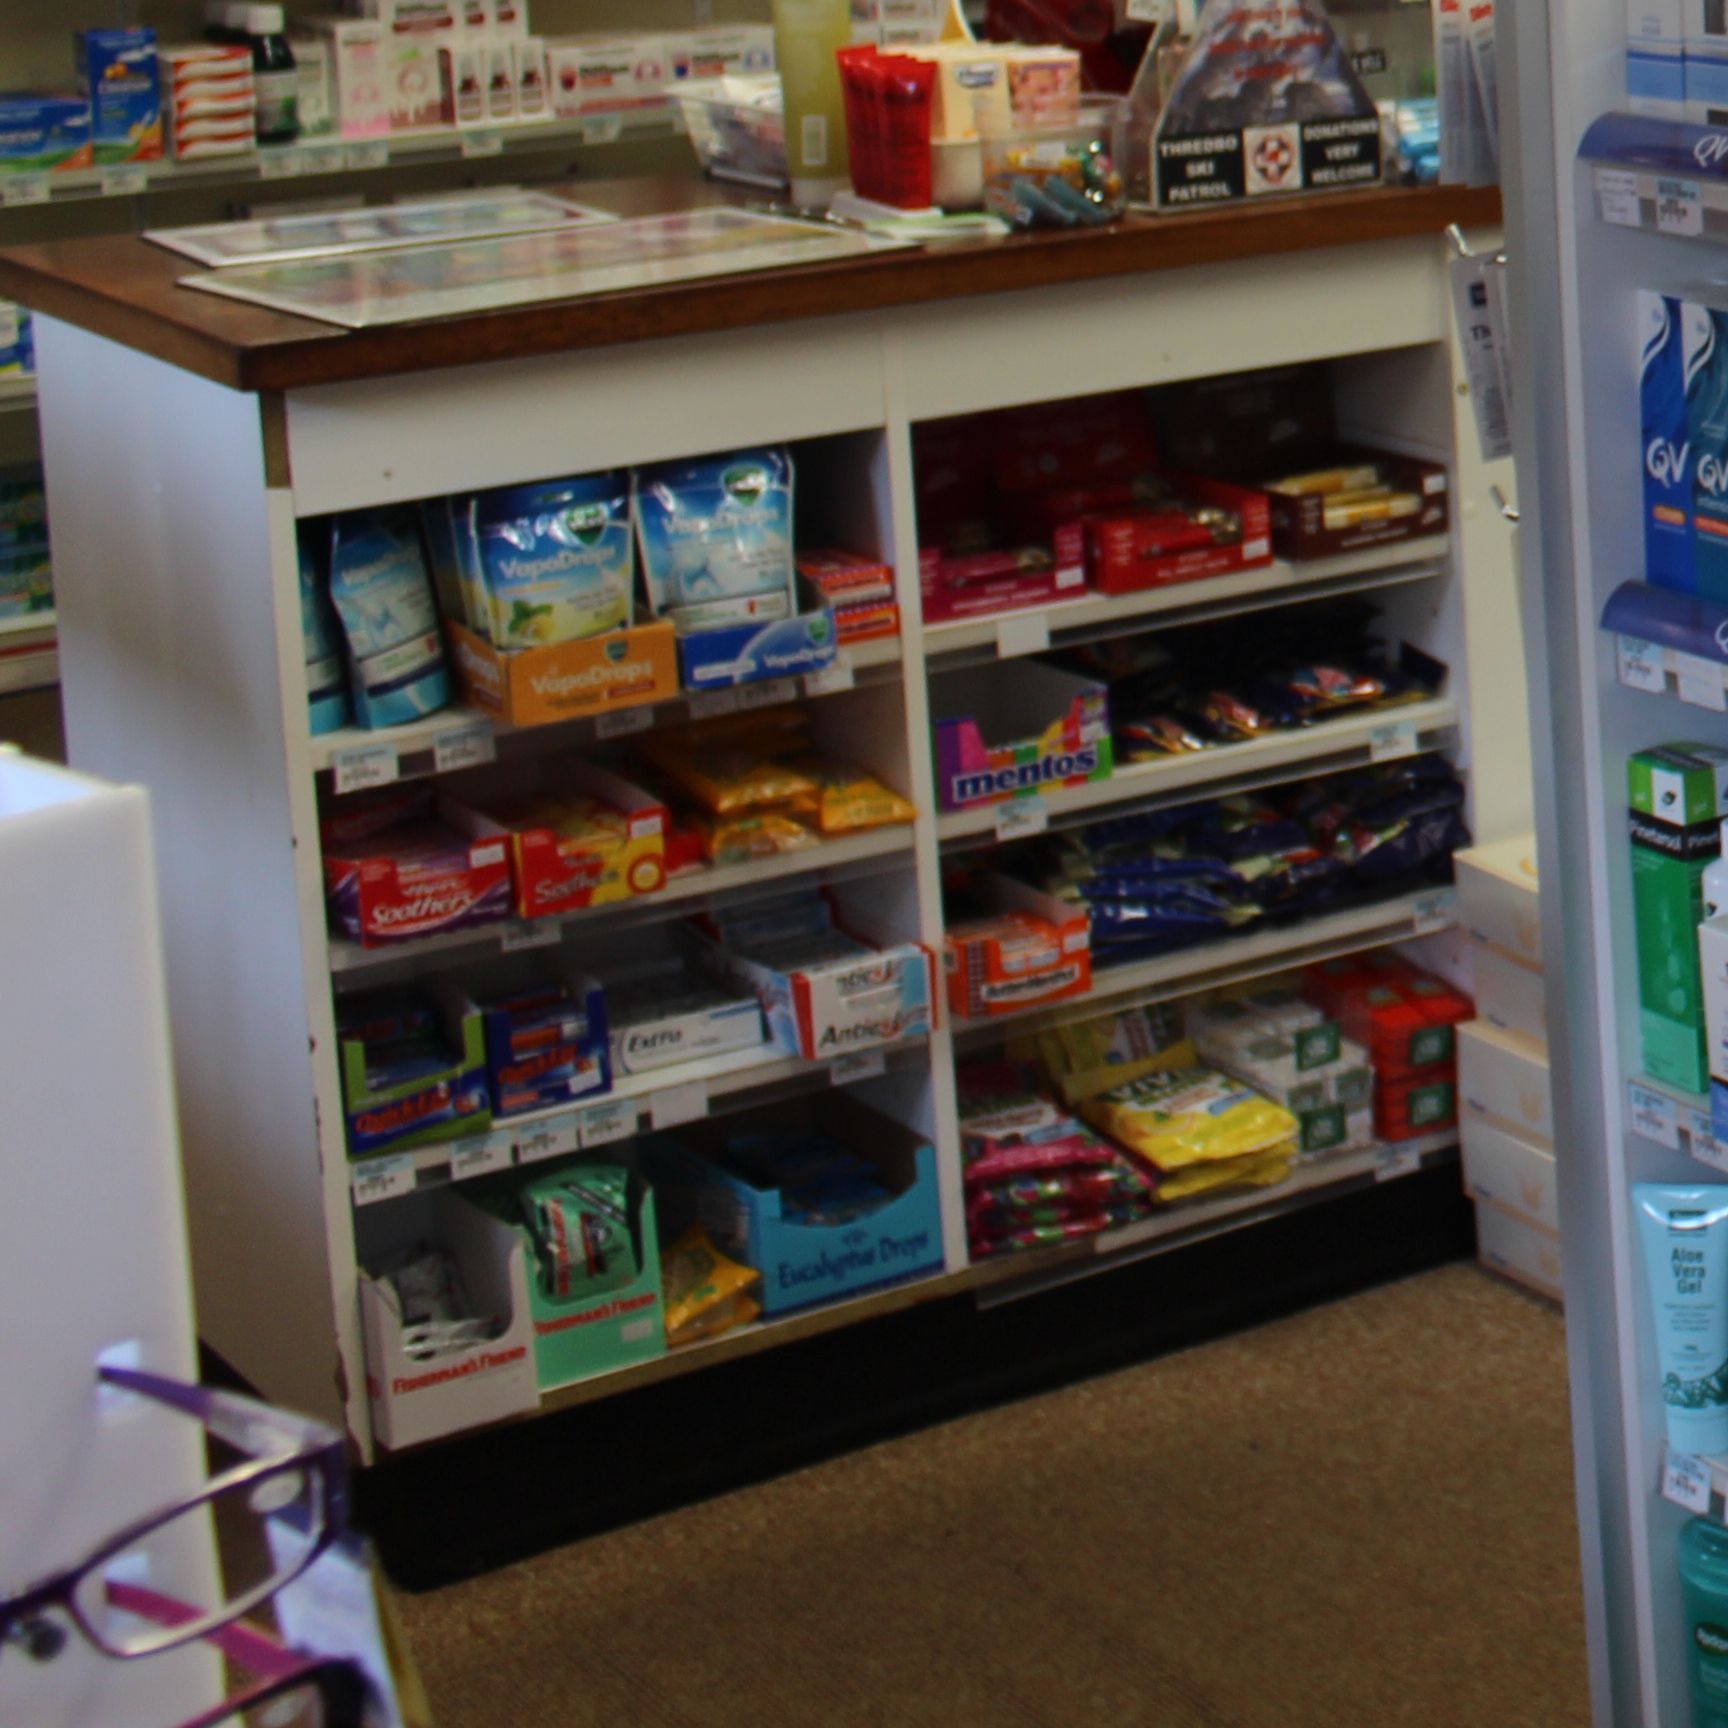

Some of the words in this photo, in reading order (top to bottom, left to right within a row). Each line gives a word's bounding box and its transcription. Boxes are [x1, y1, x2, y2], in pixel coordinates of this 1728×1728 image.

[1303, 119, 1380, 142] DONATIONS
[1160, 134, 1240, 157] THREDBO
[1325, 142, 1360, 163] VERY
[1186, 159, 1215, 179] SKI
[1311, 161, 1376, 185] WELCOME
[1167, 179, 1234, 203] PATROL
[1646, 438, 1691, 490] QV
[953, 745, 1096, 805] mentos
